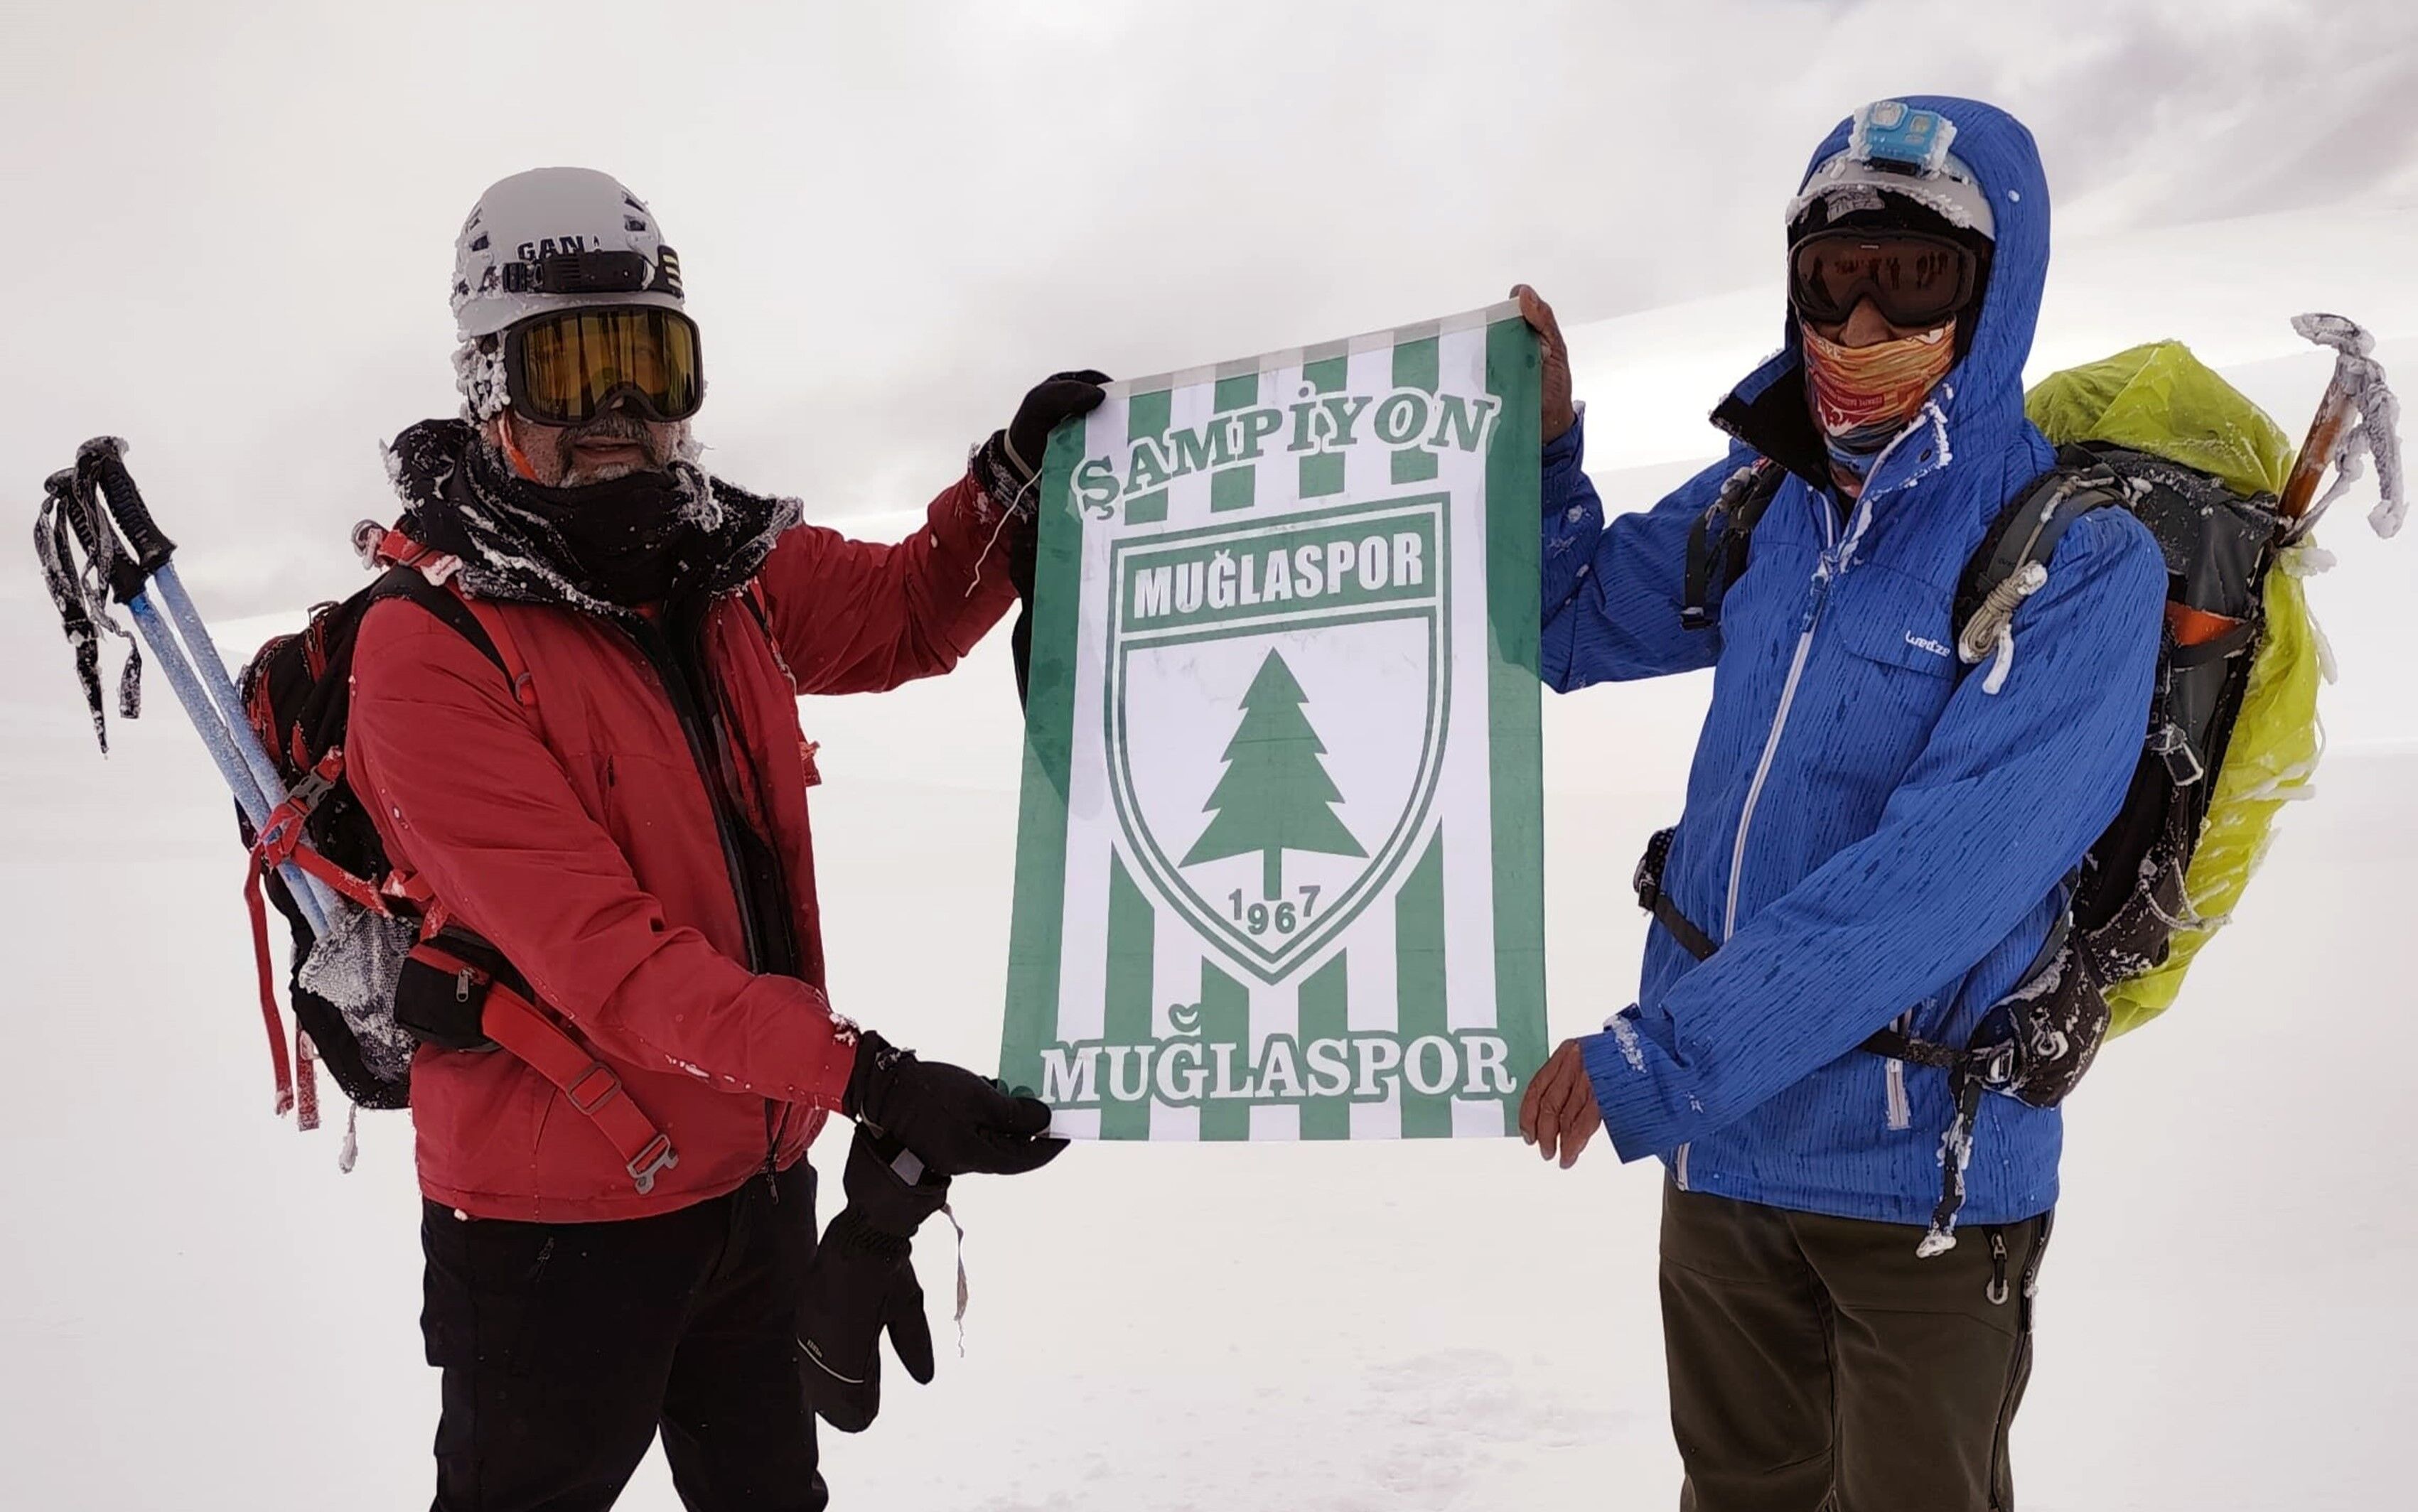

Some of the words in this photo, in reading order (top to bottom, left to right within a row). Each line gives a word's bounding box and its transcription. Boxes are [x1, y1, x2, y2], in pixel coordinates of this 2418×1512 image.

[1075, 385, 1496, 522] ŞAMPİYON
[1133, 531, 1424, 620] MUĞLASPOR
[1227, 885, 1322, 935] 1967
[1039, 1005, 1517, 1106] MUĞLASPOR
